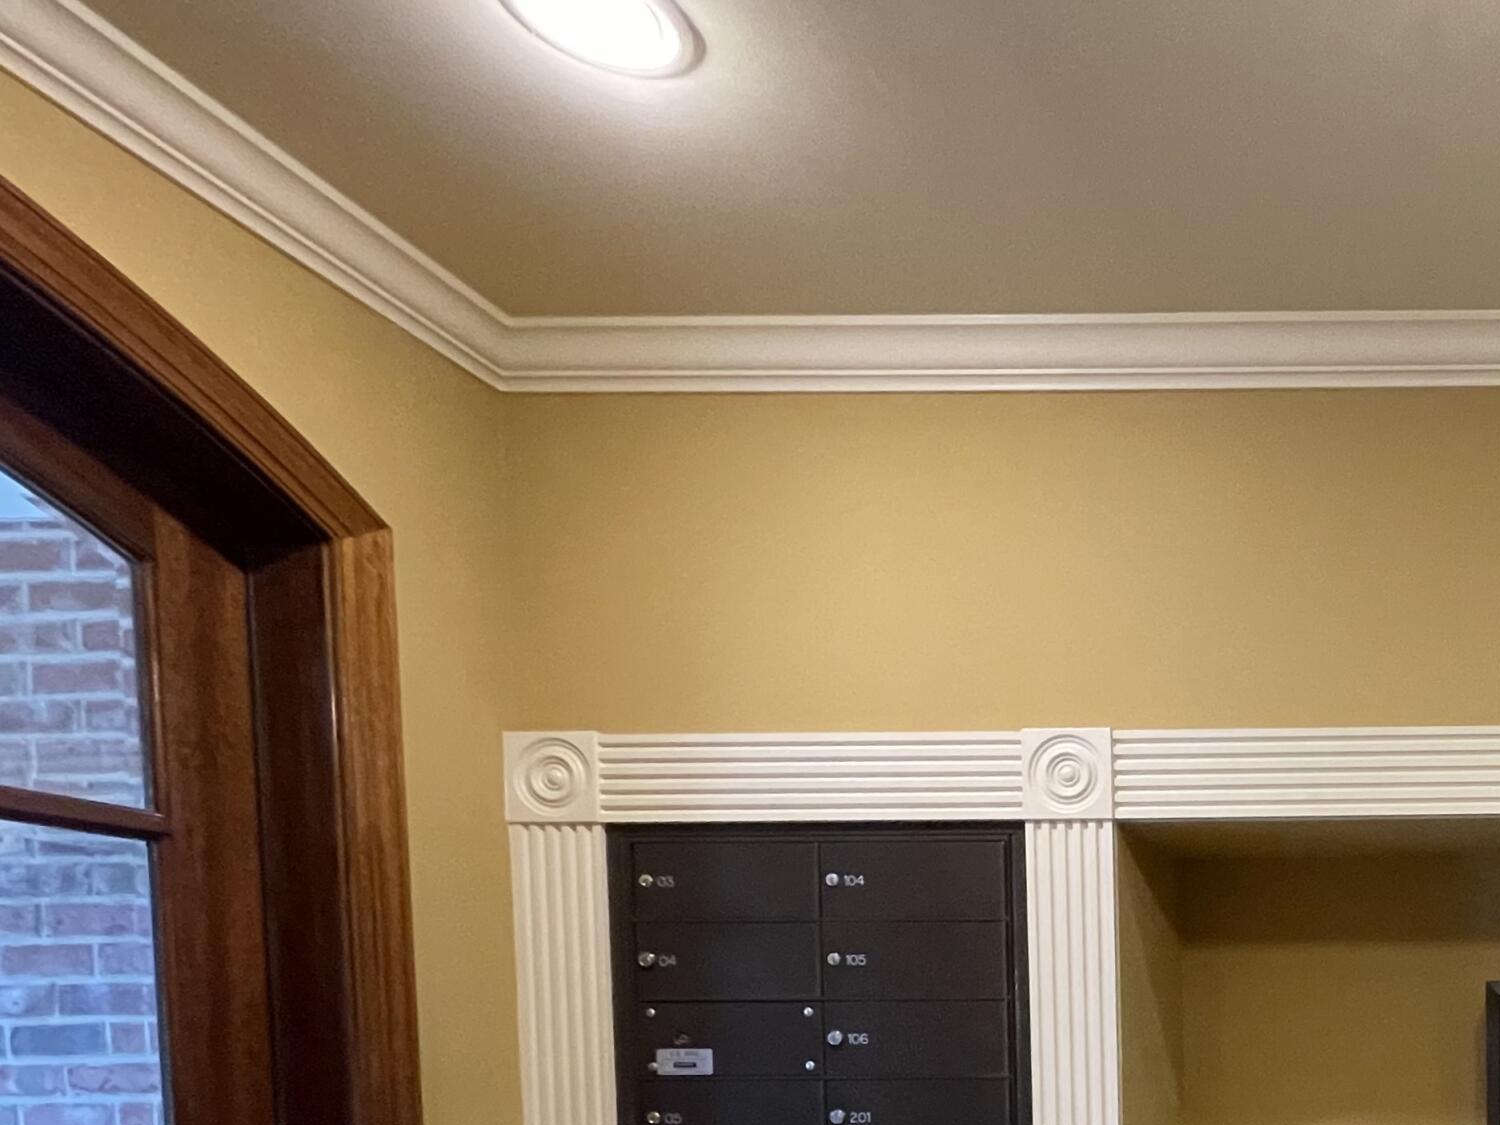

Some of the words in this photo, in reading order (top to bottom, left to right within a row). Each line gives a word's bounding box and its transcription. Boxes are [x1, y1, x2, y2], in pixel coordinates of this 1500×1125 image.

[843, 875, 865, 886] 104
[845, 954, 866, 966] 105
[847, 1033, 869, 1045] 106
[850, 1112, 872, 1124] 201
